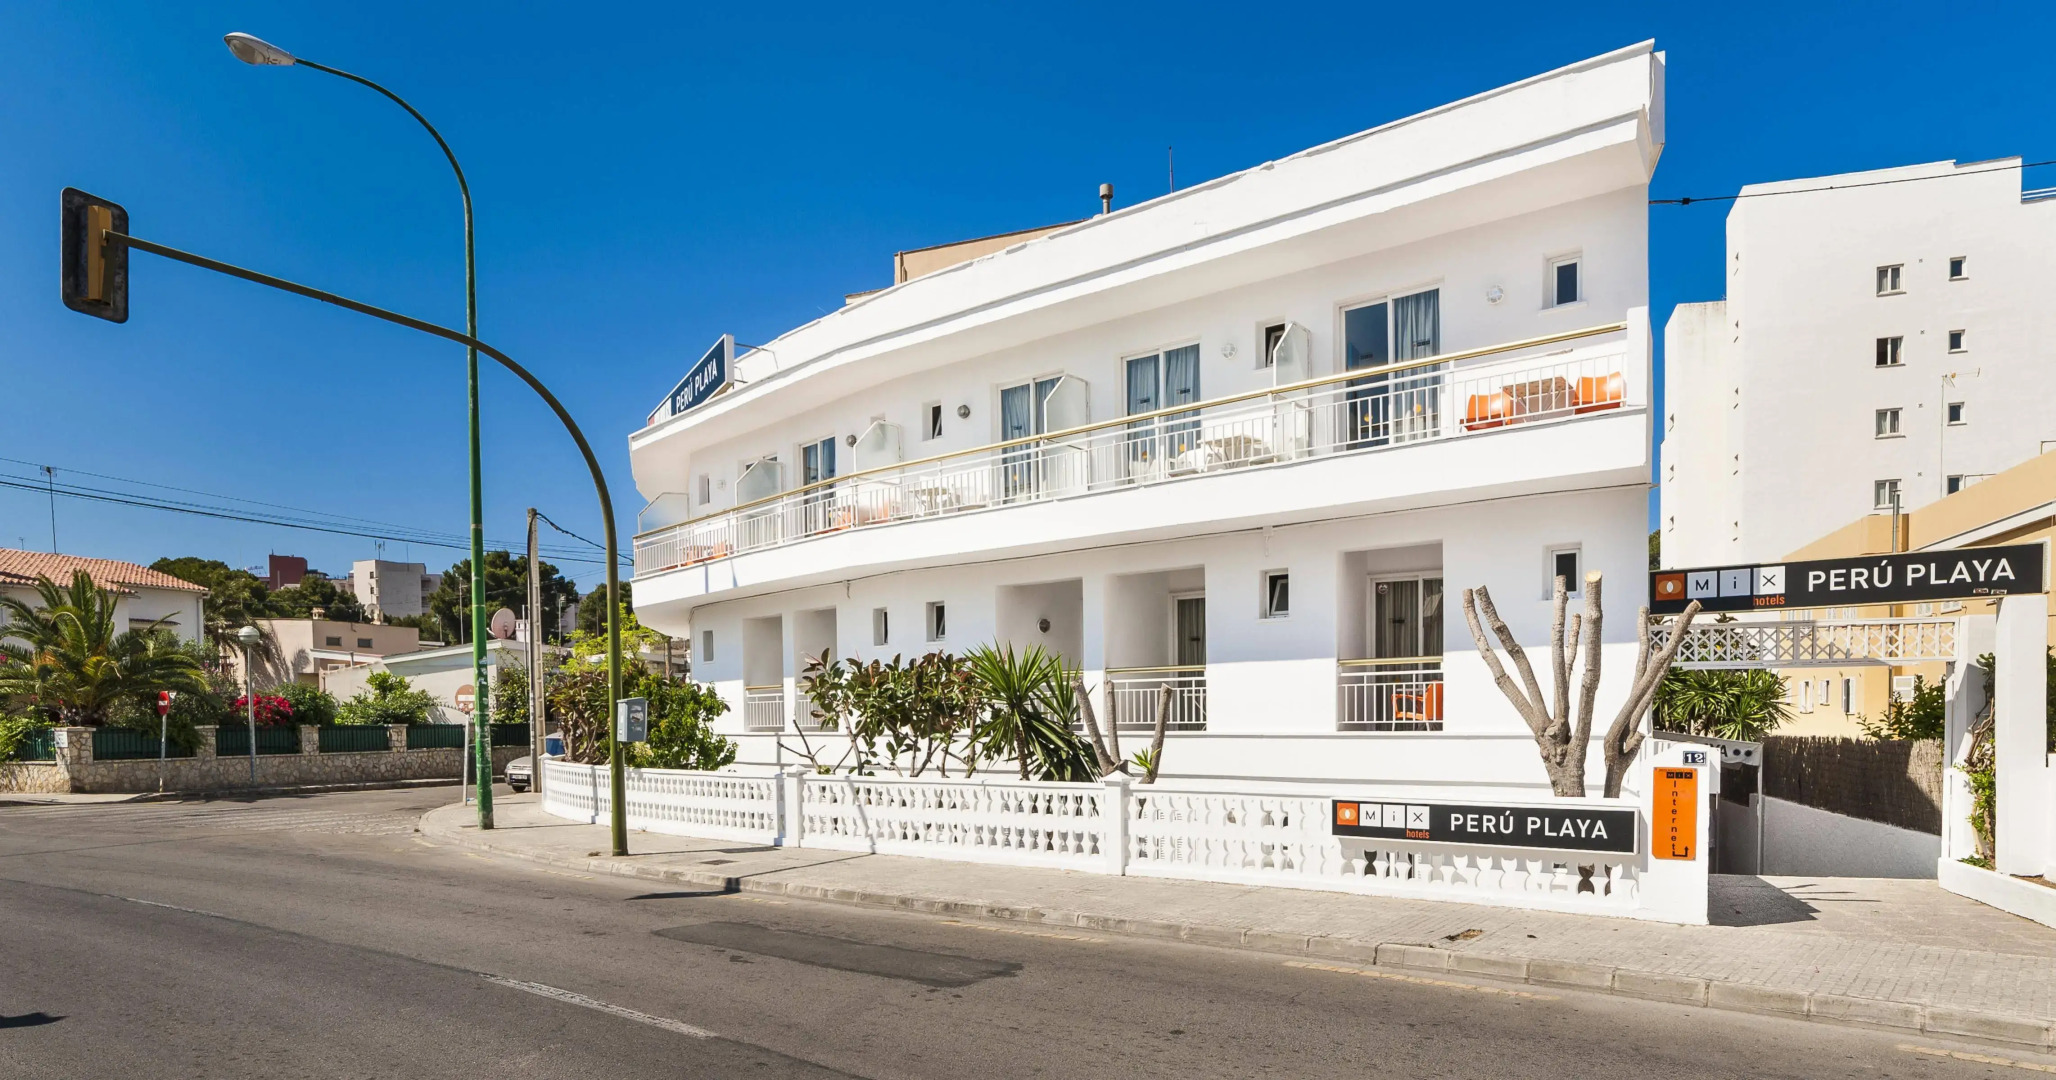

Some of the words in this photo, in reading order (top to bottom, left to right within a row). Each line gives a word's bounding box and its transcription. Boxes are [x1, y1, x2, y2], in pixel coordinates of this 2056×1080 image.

[676, 377, 693, 414] PERÚ
[695, 358, 718, 396] PLAYA
[1808, 560, 1892, 592] PERÚ
[1907, 558, 2016, 587] PLAYA
[1753, 595, 1785, 606] hotels
[1686, 752, 1704, 763] 12
[1406, 828, 1430, 839] hotels
[1450, 811, 1514, 834] PERÚ
[1527, 818, 1608, 839] PLAYA
